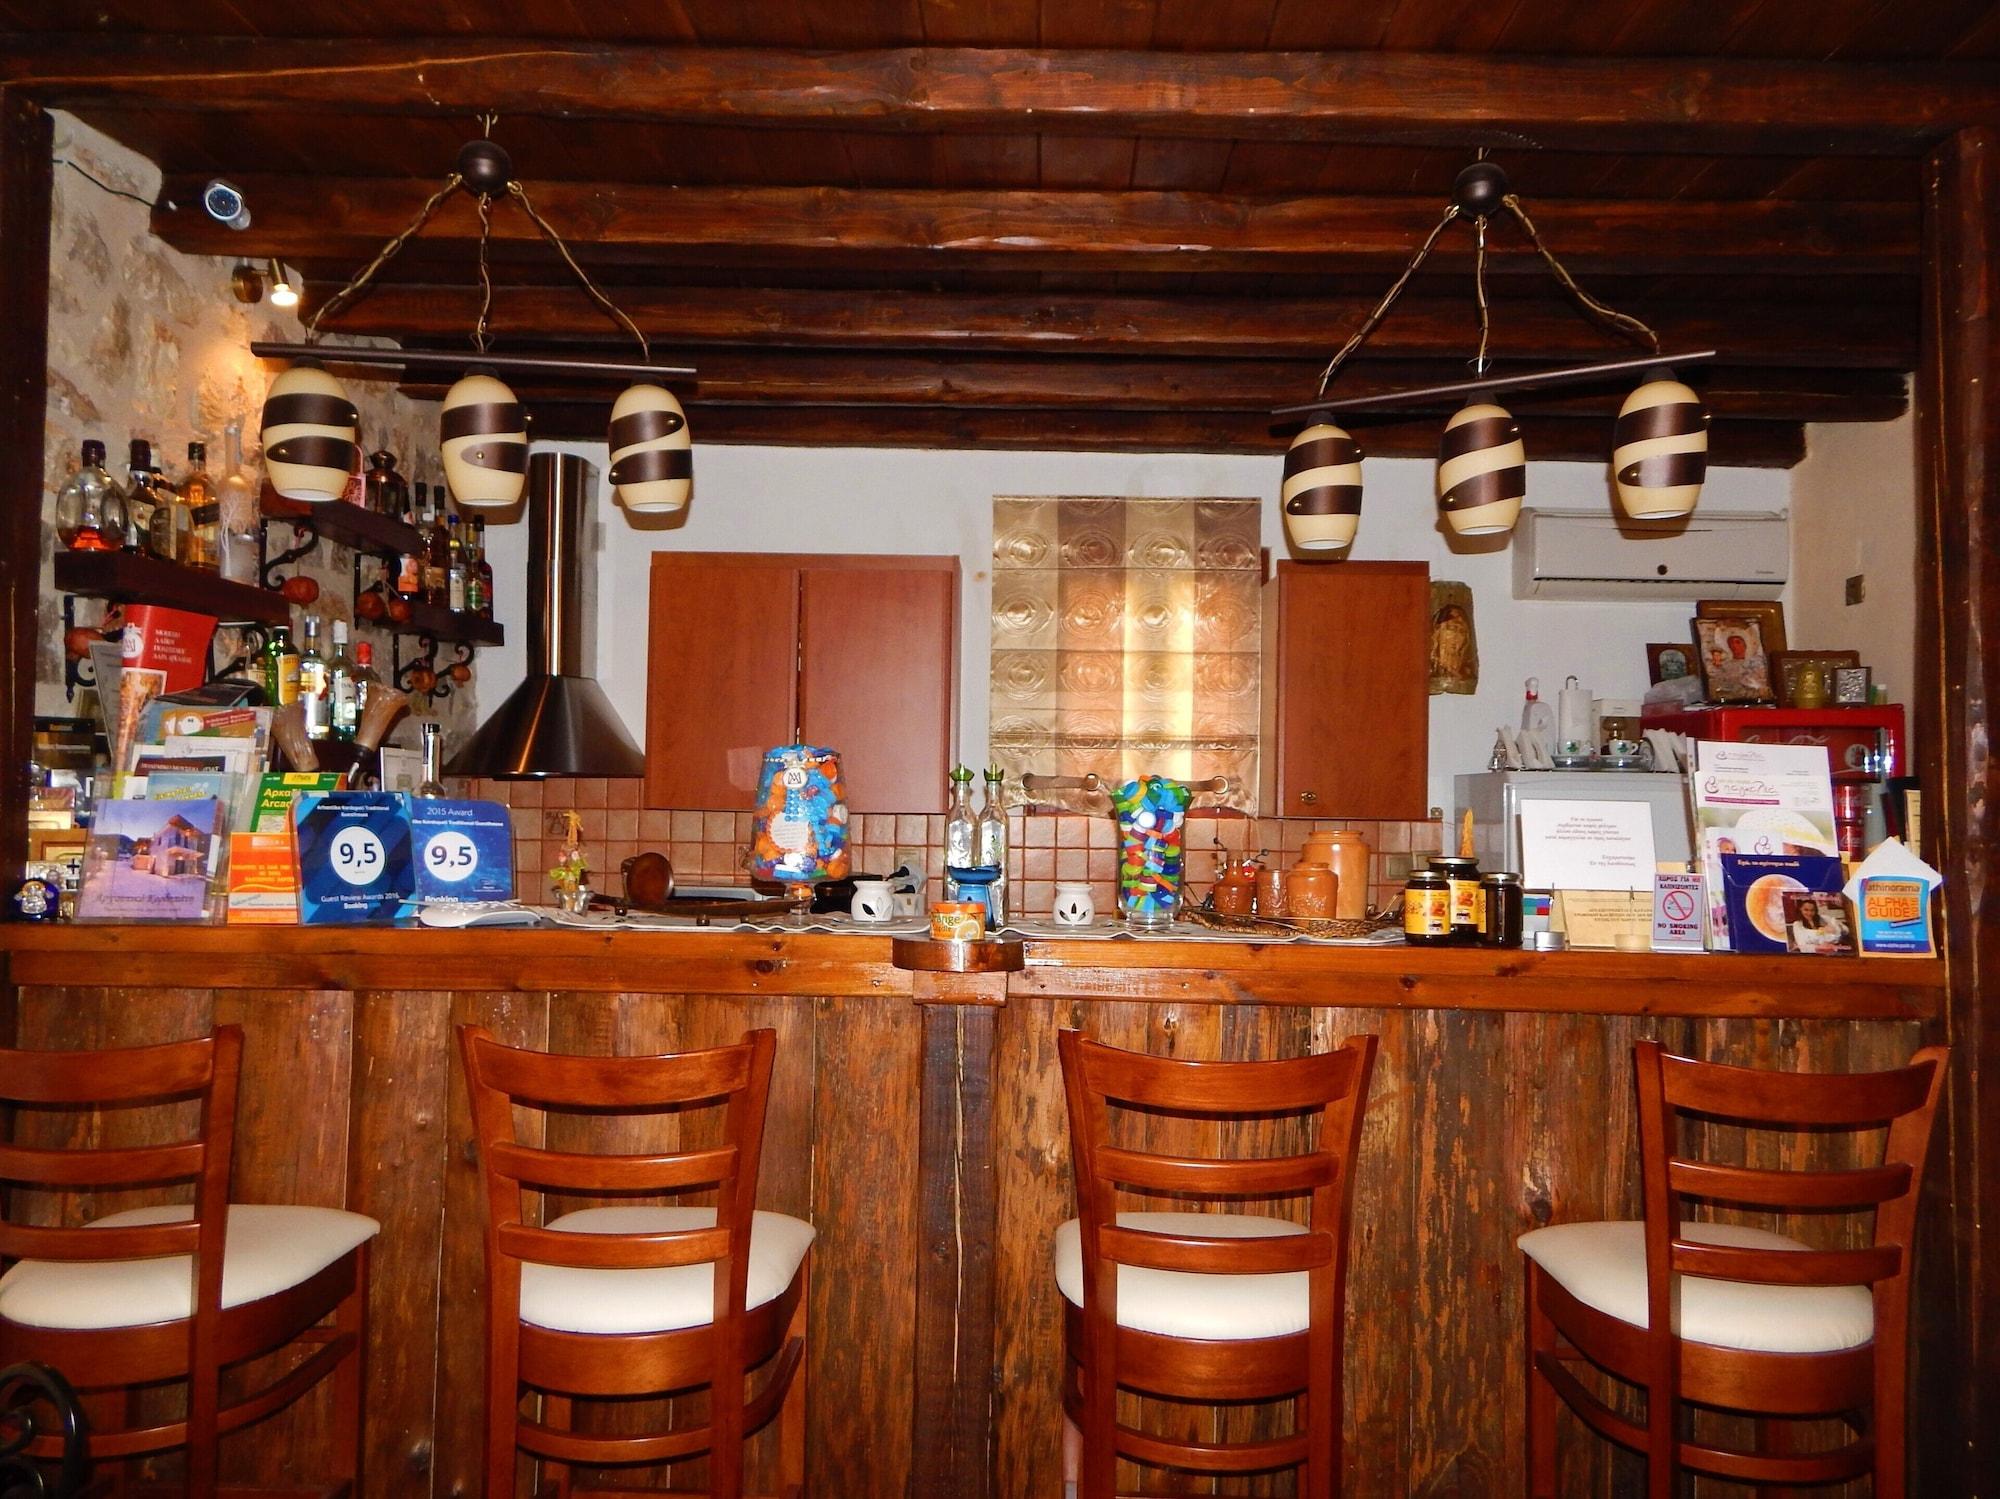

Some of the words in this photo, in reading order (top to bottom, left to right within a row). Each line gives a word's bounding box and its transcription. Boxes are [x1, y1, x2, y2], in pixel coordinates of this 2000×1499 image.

[426, 807, 447, 816] 2015
[447, 808, 473, 816] Award
[339, 842, 377, 868] 9,5
[431, 845, 472, 868] 9,5
[1867, 881, 1920, 892] athinorama
[1867, 897, 1909, 908] ALPHA
[1867, 907, 1911, 918] GUIDE
